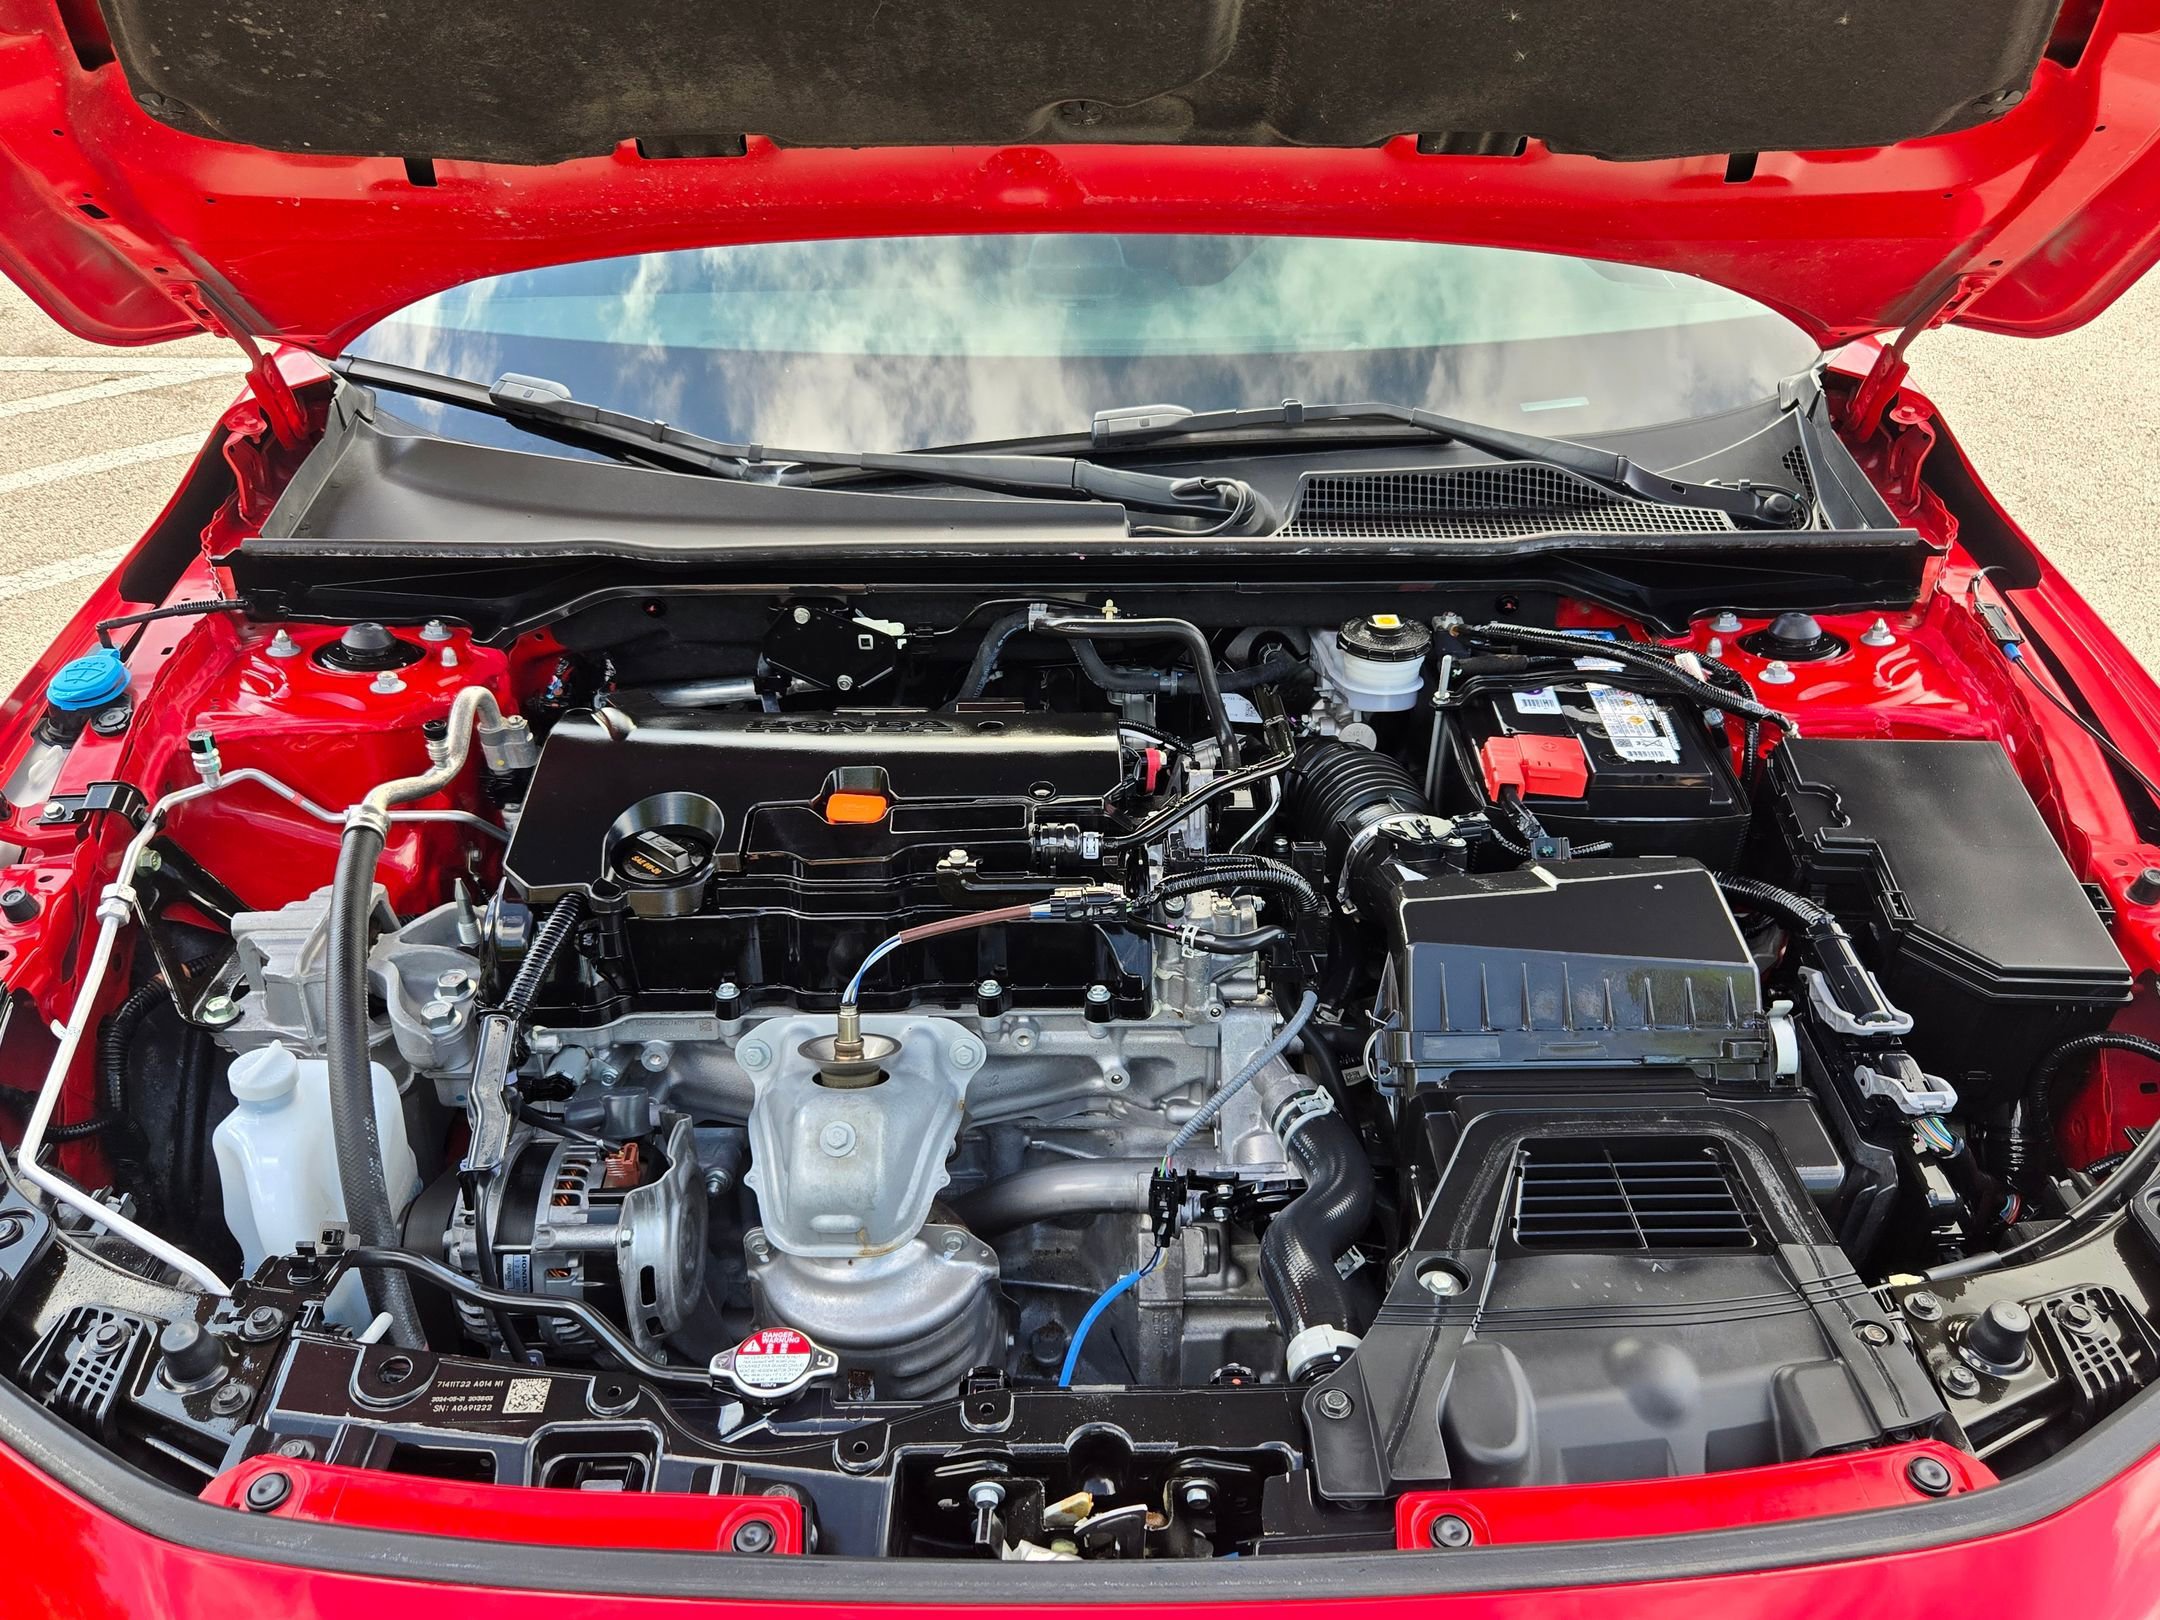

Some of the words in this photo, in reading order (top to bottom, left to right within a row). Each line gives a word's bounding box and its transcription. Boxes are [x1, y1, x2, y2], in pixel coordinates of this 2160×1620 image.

[744, 719, 954, 733] HONDA
[473, 1380, 492, 1388] A014
[432, 1404, 450, 1413] SN:
[451, 1404, 493, 1412] A0691222
